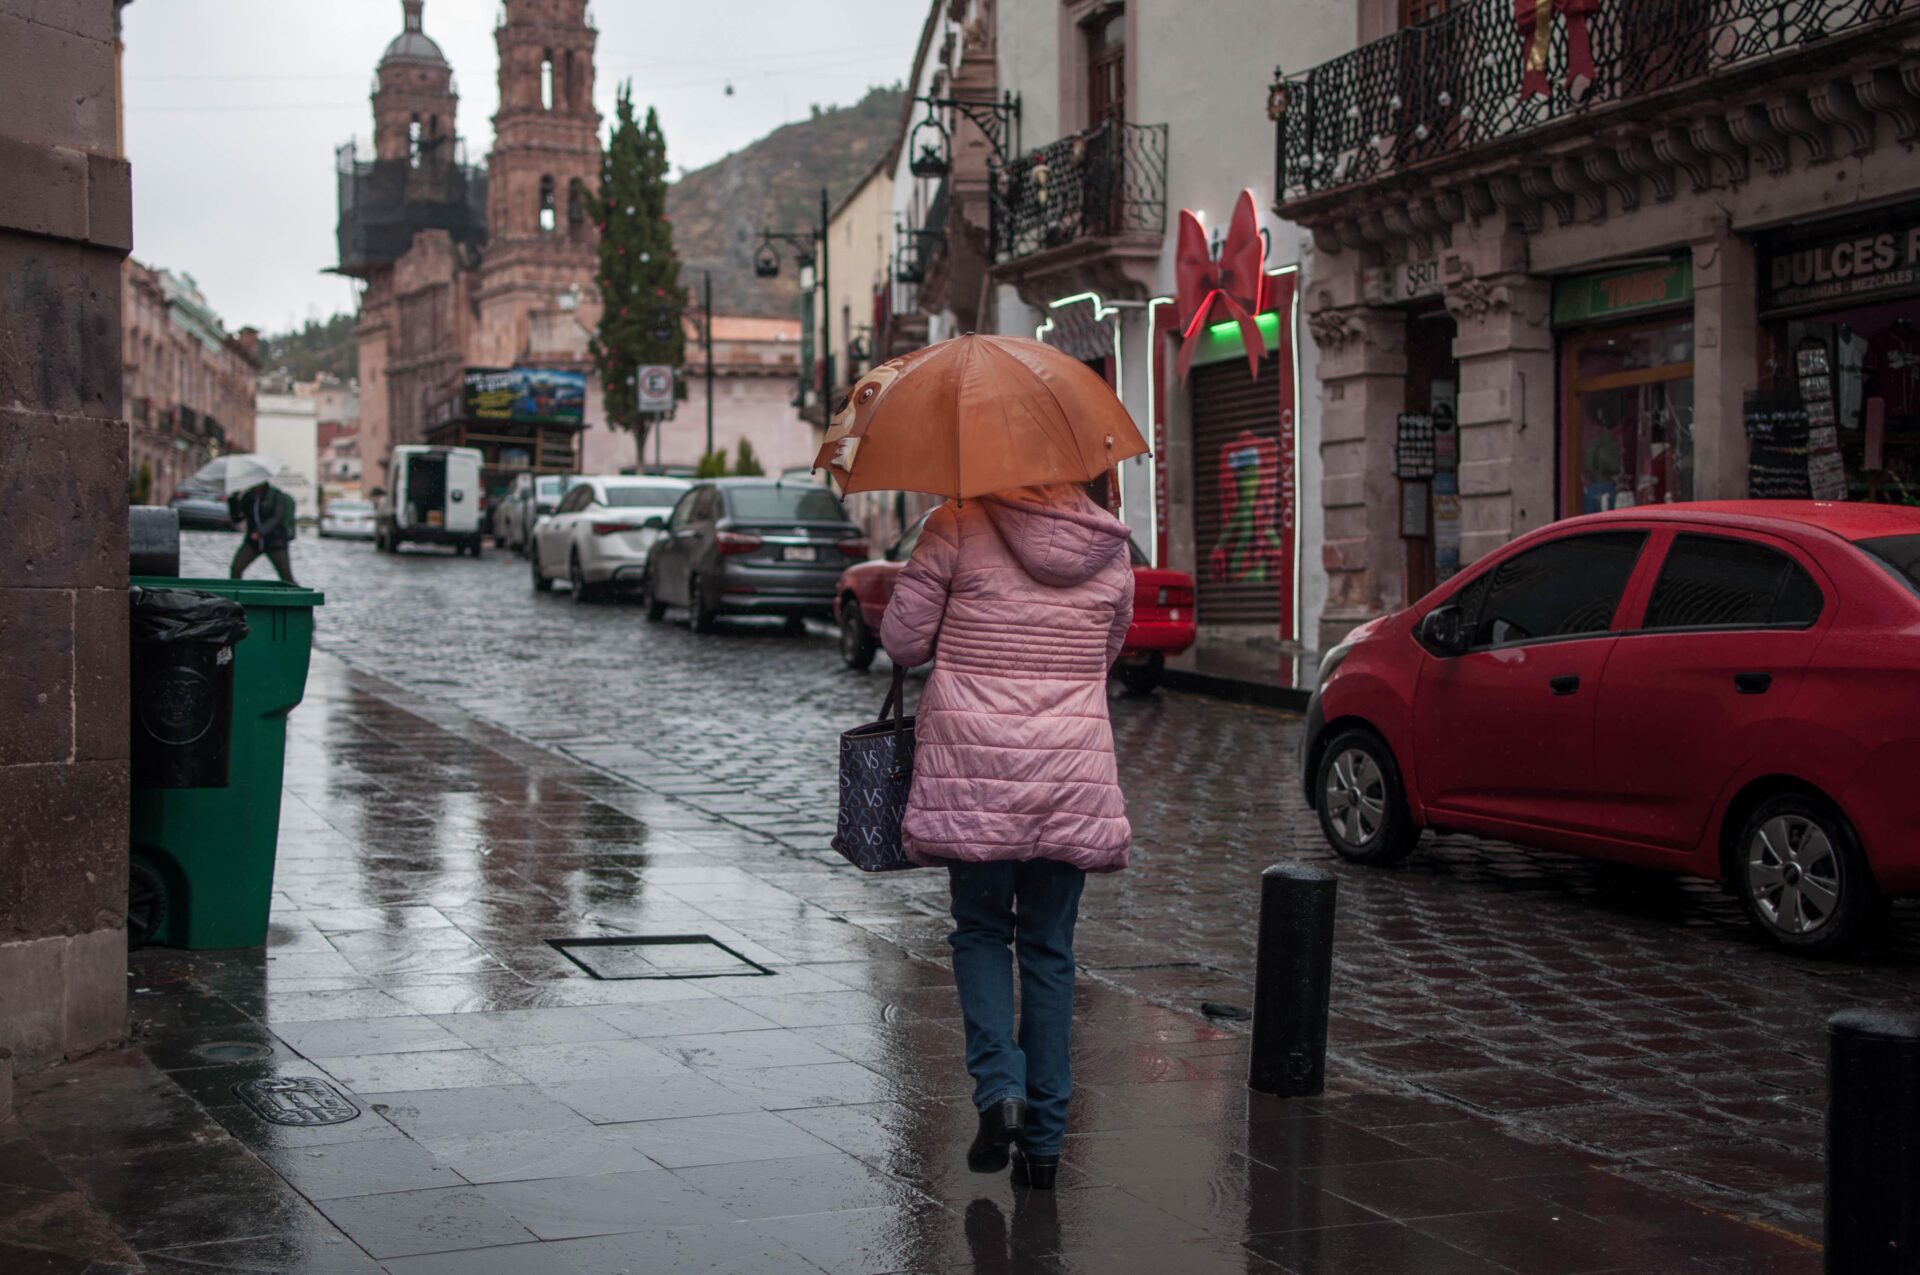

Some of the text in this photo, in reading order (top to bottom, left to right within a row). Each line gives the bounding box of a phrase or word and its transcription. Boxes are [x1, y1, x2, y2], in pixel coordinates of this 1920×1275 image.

[1771, 233, 1895, 289] DULCES
[1852, 269, 1913, 293] MEZCALES
[862, 749, 879, 769] VS
[862, 787, 883, 808] VS
[860, 826, 883, 846] VS
